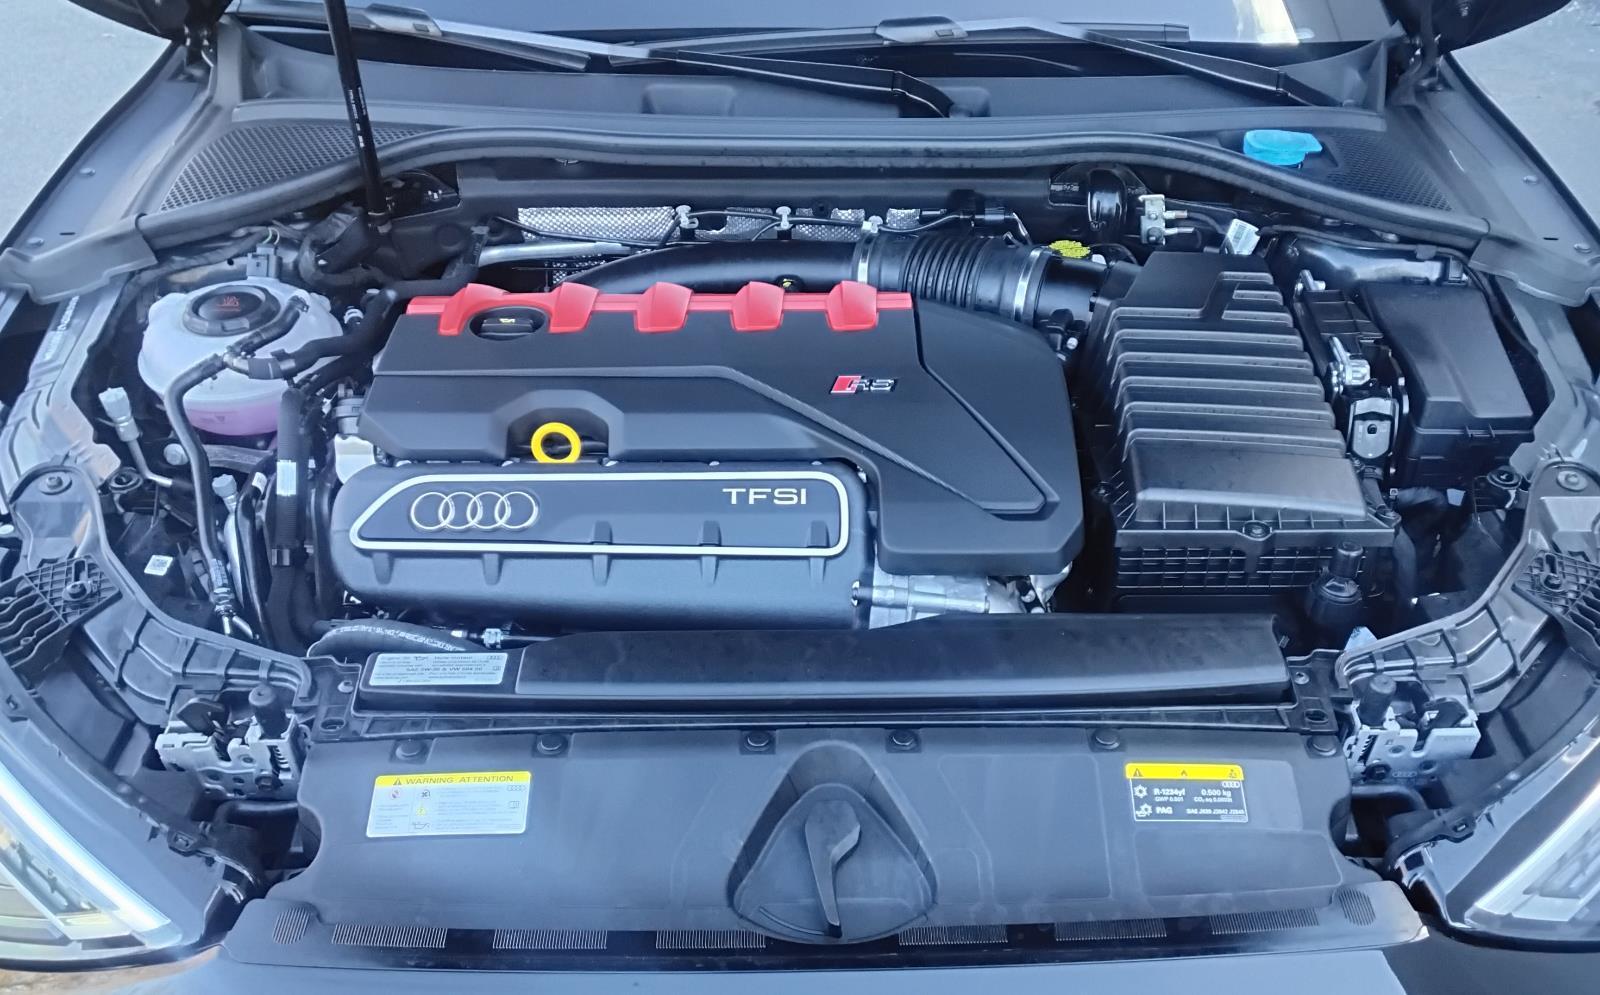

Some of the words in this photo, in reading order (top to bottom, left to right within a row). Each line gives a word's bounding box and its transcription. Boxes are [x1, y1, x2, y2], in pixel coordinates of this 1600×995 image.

[722, 488, 807, 505] TFSI
[406, 777, 454, 785] WARNING
[459, 775, 514, 783] ATTENTION
[1153, 787, 1186, 796] R-1234yf
[1201, 788, 1221, 796] 0.500
[1222, 789, 1232, 797] kg
[1155, 806, 1173, 814] PAG
